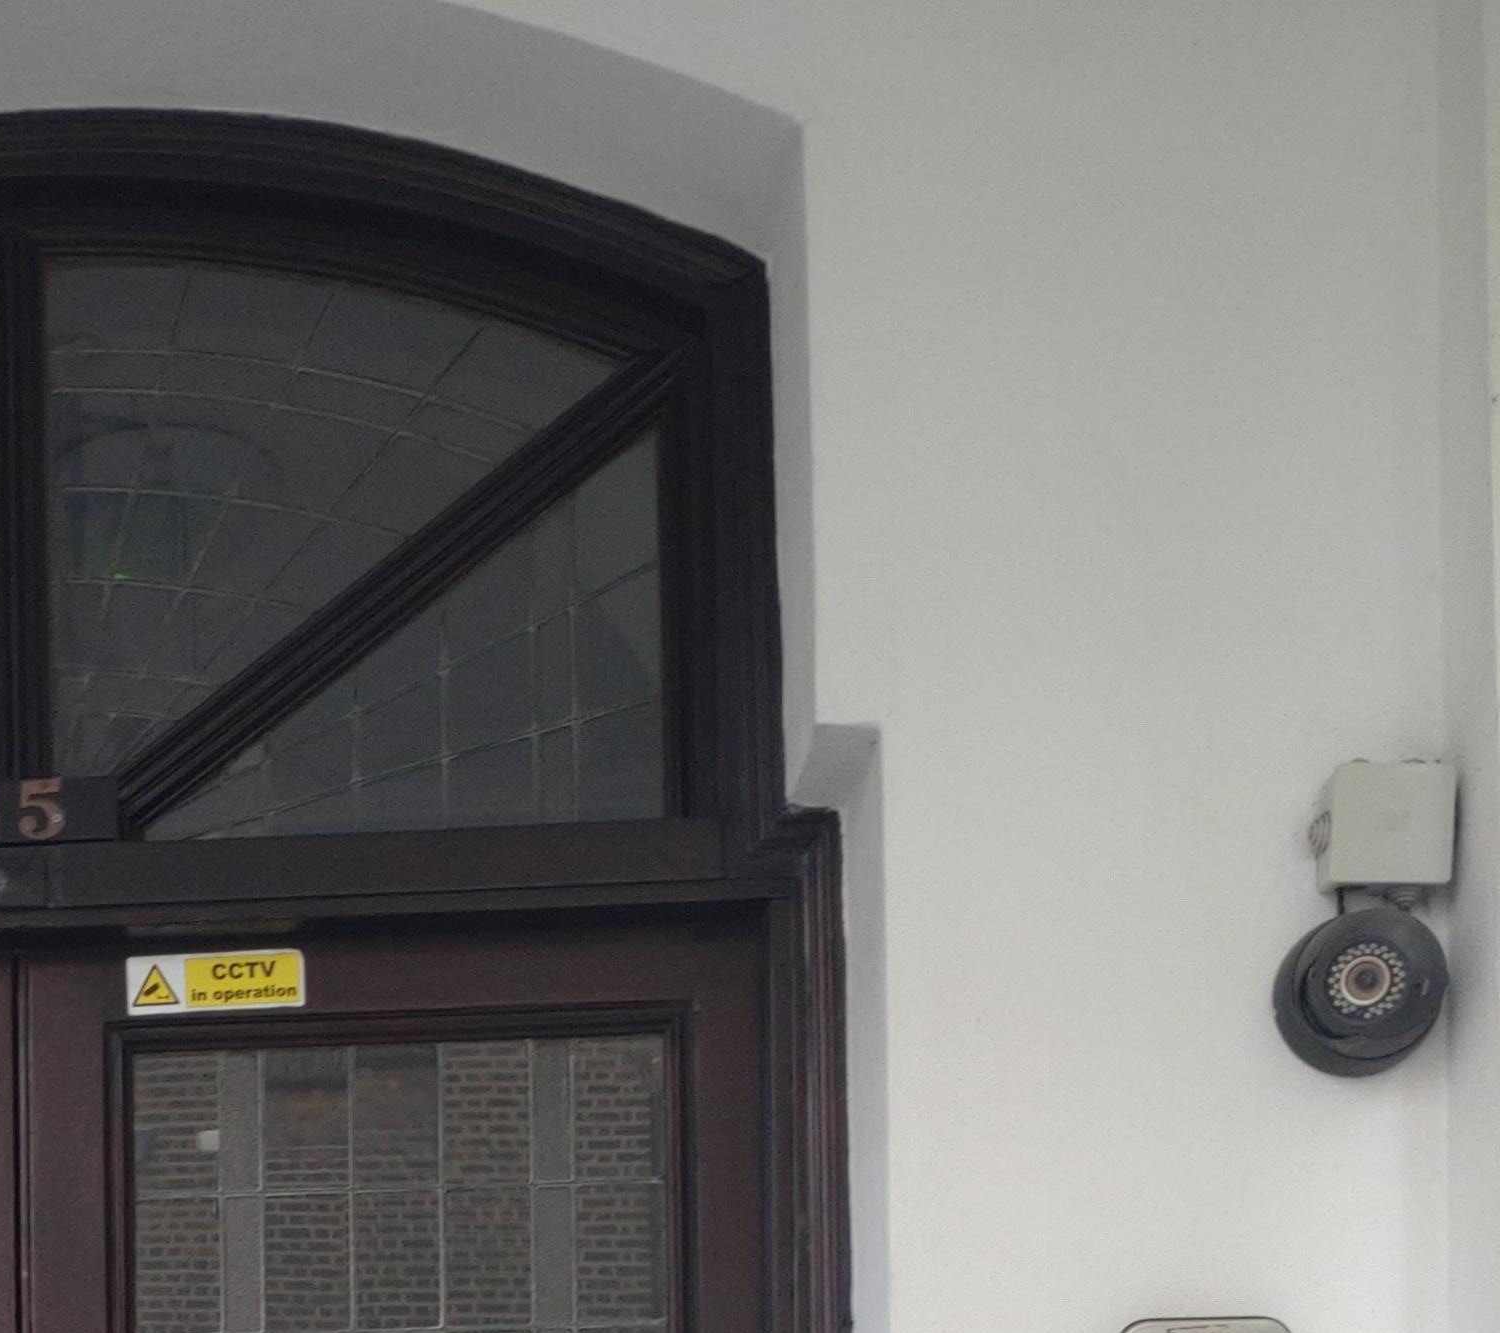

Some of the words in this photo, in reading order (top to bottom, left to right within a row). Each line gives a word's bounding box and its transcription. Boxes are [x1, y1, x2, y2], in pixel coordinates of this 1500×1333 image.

[211, 961, 277, 981] CCTV
[191, 988, 208, 1002] in
[212, 985, 298, 1003] operation
